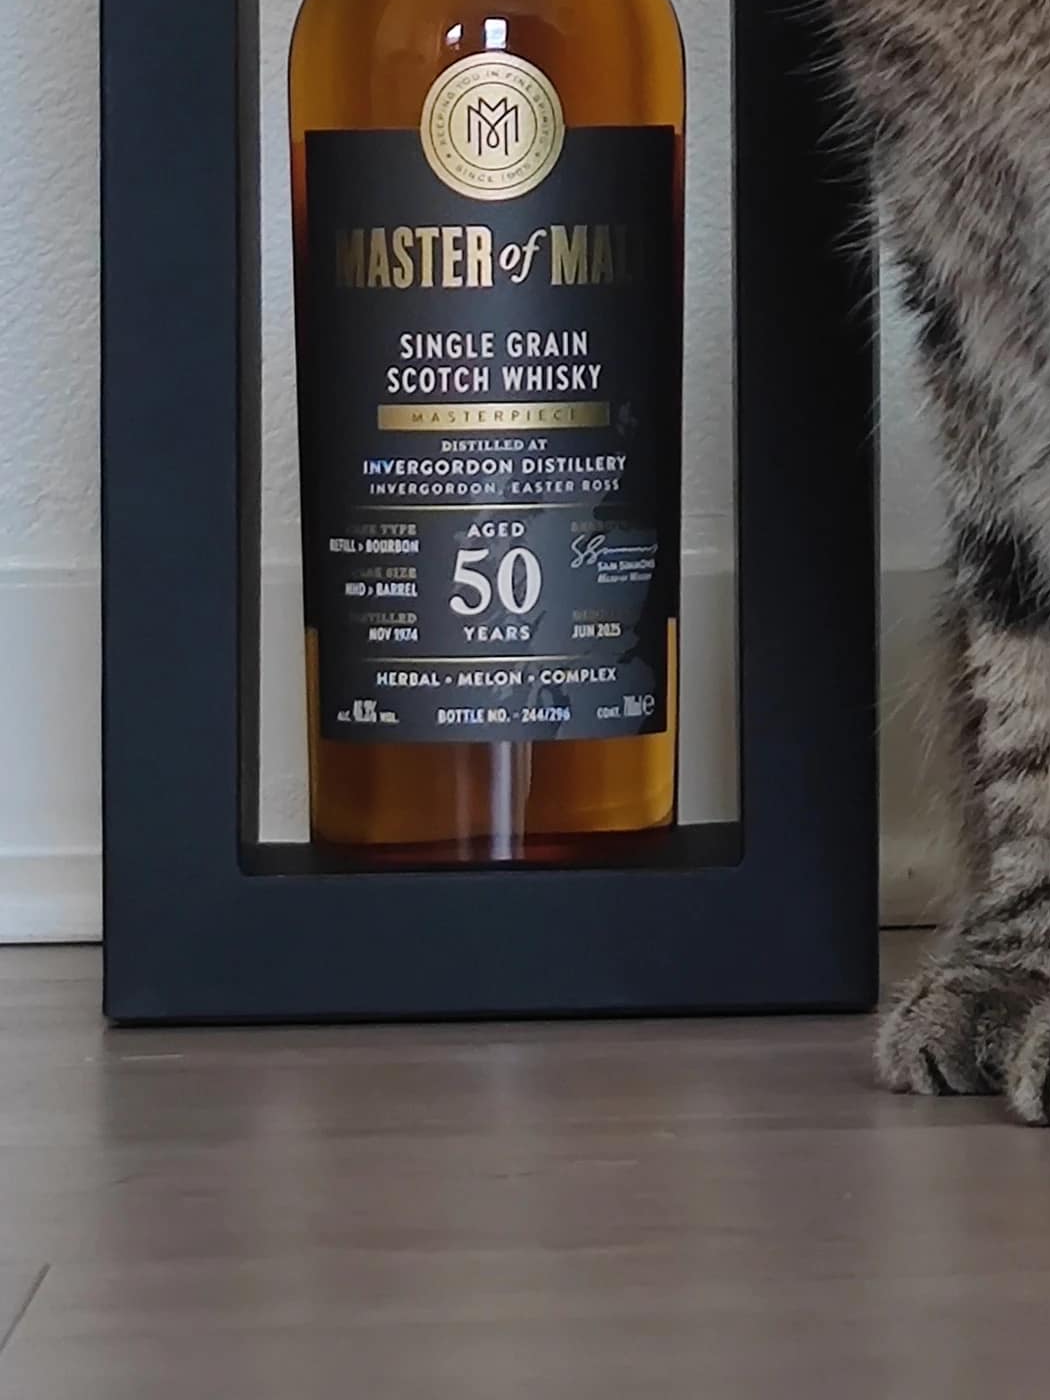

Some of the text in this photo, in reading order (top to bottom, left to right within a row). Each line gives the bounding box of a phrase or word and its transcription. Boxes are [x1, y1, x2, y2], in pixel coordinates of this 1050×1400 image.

[500, 229, 546, 284] of
[400, 331, 588, 359] SINGLE GRAIN
[387, 364, 601, 393] SCOTCH WHISKY
[441, 438, 548, 452] DISTILLED AT
[363, 456, 626, 475] INVERGORDON DISTILLERY
[512, 481, 573, 493] EASTER
[581, 478, 619, 491] ROSS
[467, 522, 524, 538] AGED
[366, 539, 419, 553] BOURBON
[376, 582, 418, 597] BARREL
[450, 548, 542, 615] 50
[368, 627, 392, 641] NOV
[464, 625, 530, 641] YEARS
[572, 624, 595, 638] JUN
[377, 668, 617, 686] HERBAL MELON COMPLEX
[438, 709, 485, 724] BOTTLE
[487, 708, 511, 723] NO.
